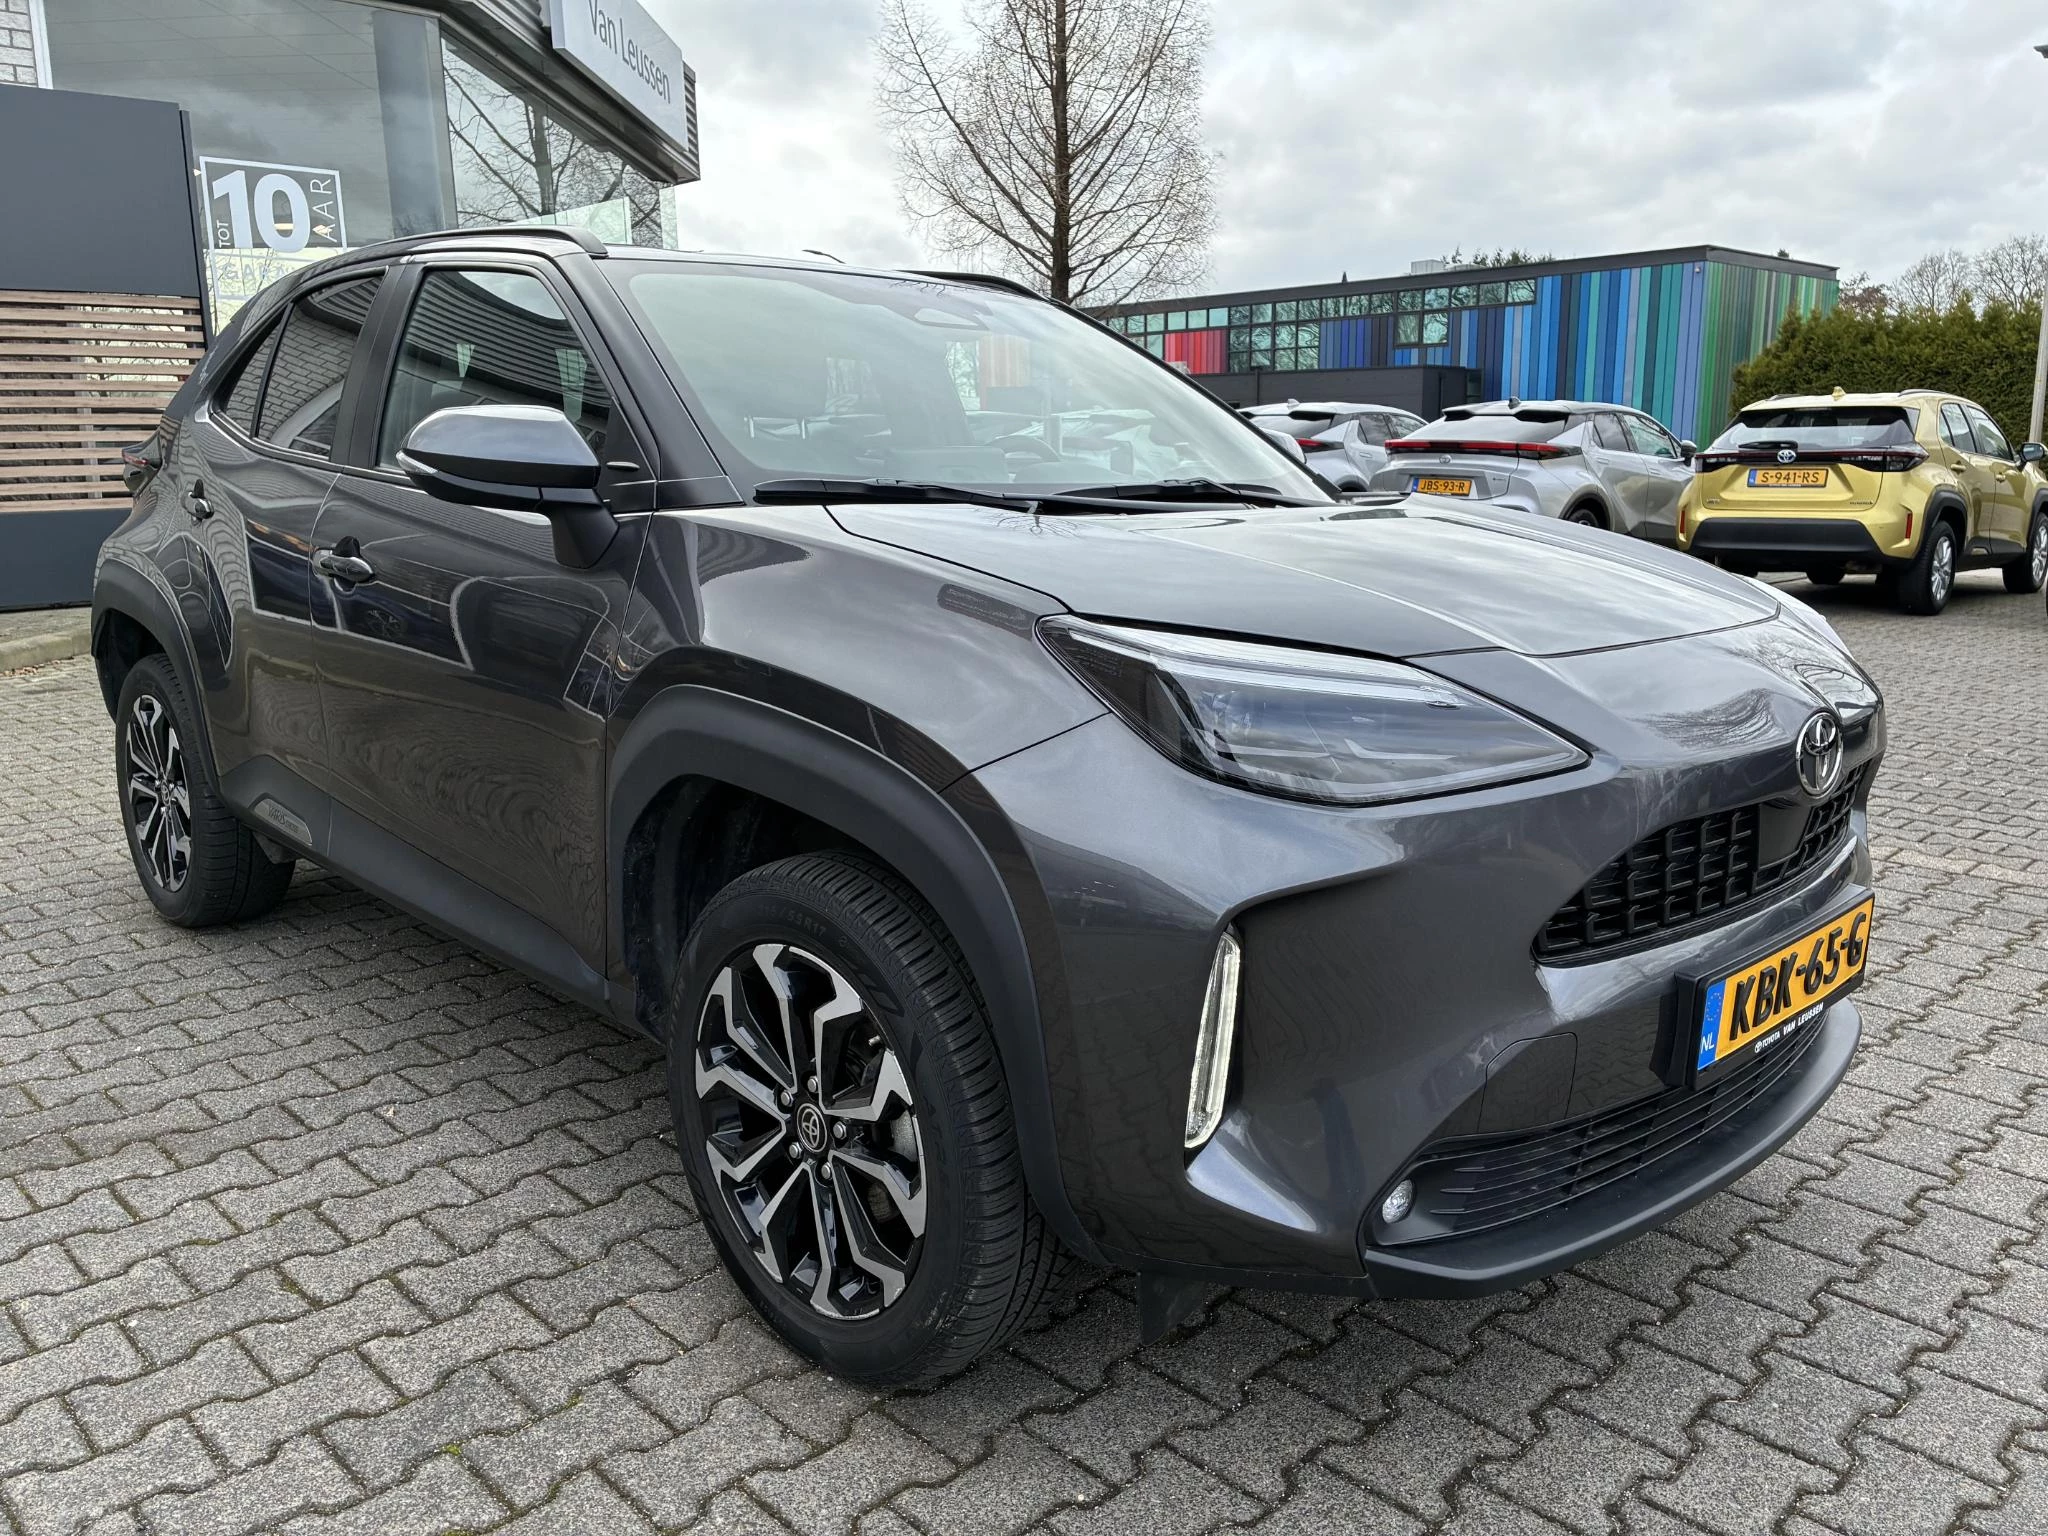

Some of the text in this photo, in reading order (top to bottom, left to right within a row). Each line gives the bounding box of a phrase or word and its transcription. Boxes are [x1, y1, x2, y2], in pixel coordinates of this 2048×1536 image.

[588, 0, 671, 104] Van Leussen
[212, 169, 311, 253] 10
[216, 219, 231, 248] TOT
[1420, 479, 1465, 491] JBS-93-R
[1760, 471, 1820, 483] S-941-RS
[1729, 912, 1867, 1041] KBK-65-G
[1701, 1031, 1715, 1052] NL
[1761, 1002, 1824, 1048] TOYOTA VAN LEUSSEN
